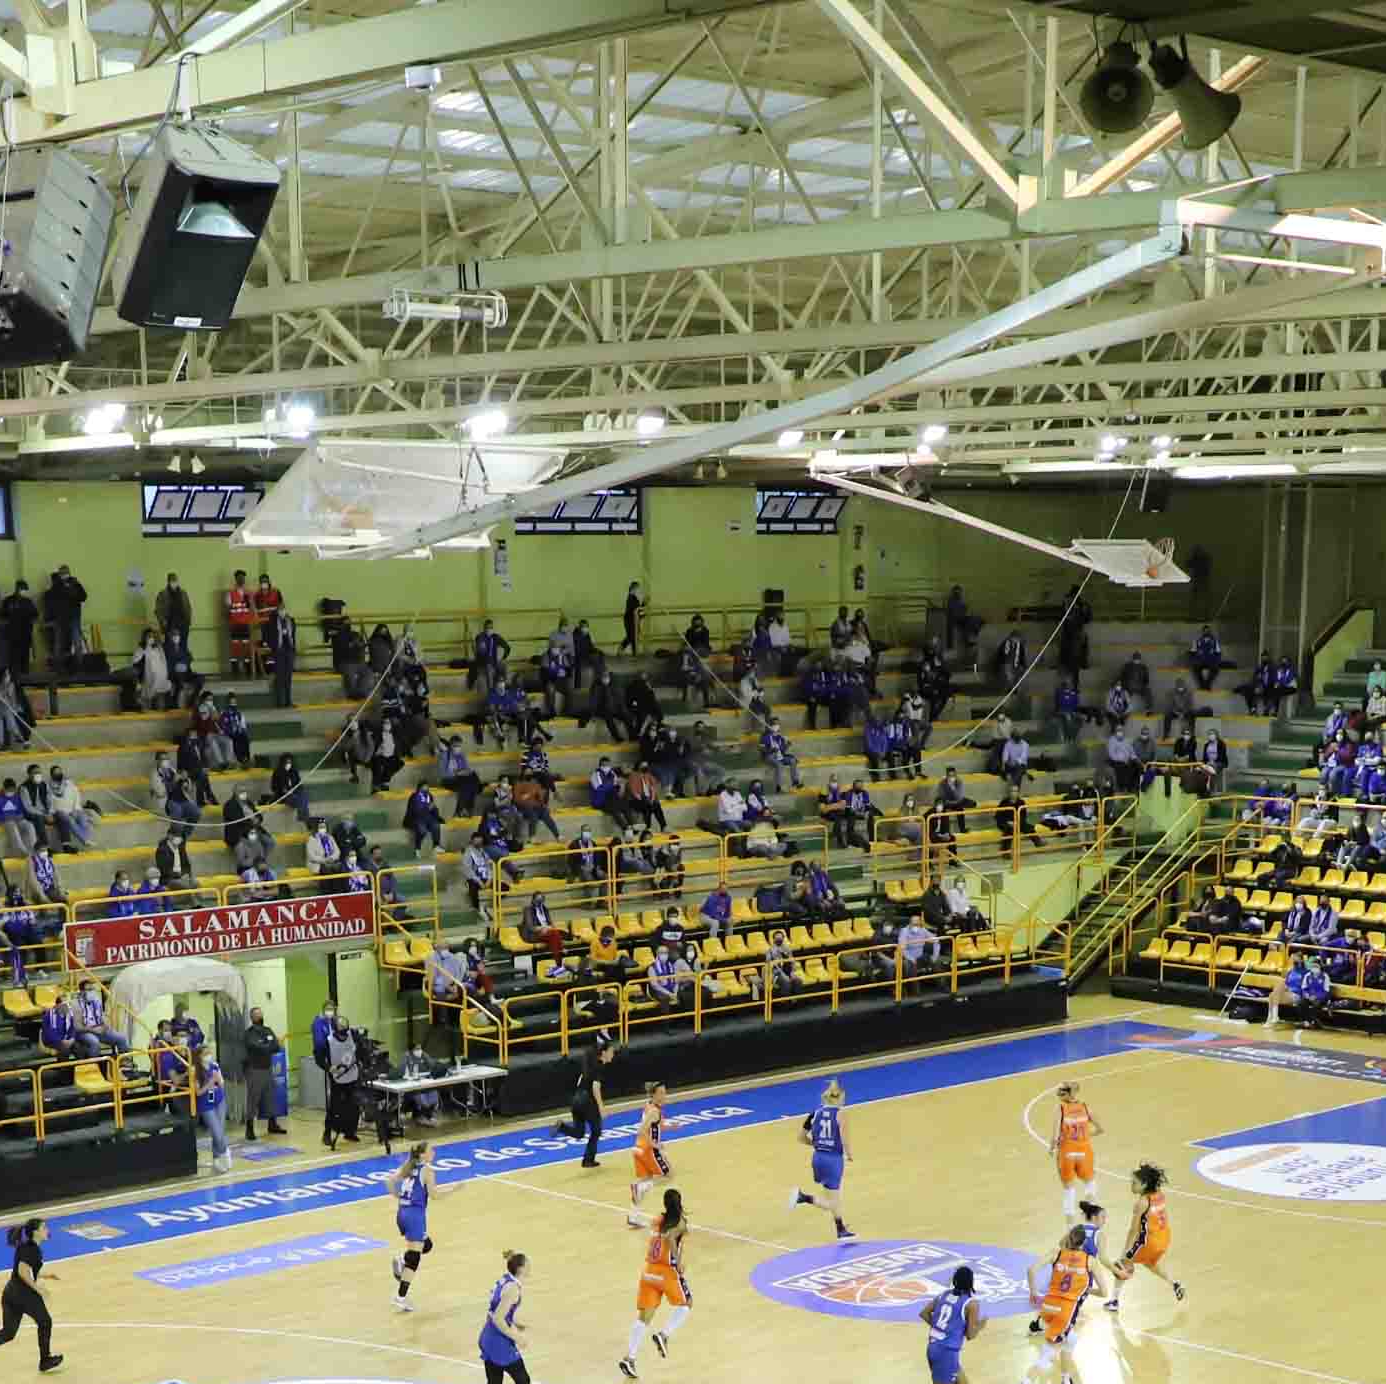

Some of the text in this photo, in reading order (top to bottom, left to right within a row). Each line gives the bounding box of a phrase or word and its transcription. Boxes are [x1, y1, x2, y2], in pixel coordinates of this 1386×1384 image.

[139, 899, 342, 940] SALAMANCA
[105, 918, 366, 964] PATRIMONIO DE LA HUMANIDAD
[476, 1147, 534, 1162] de
